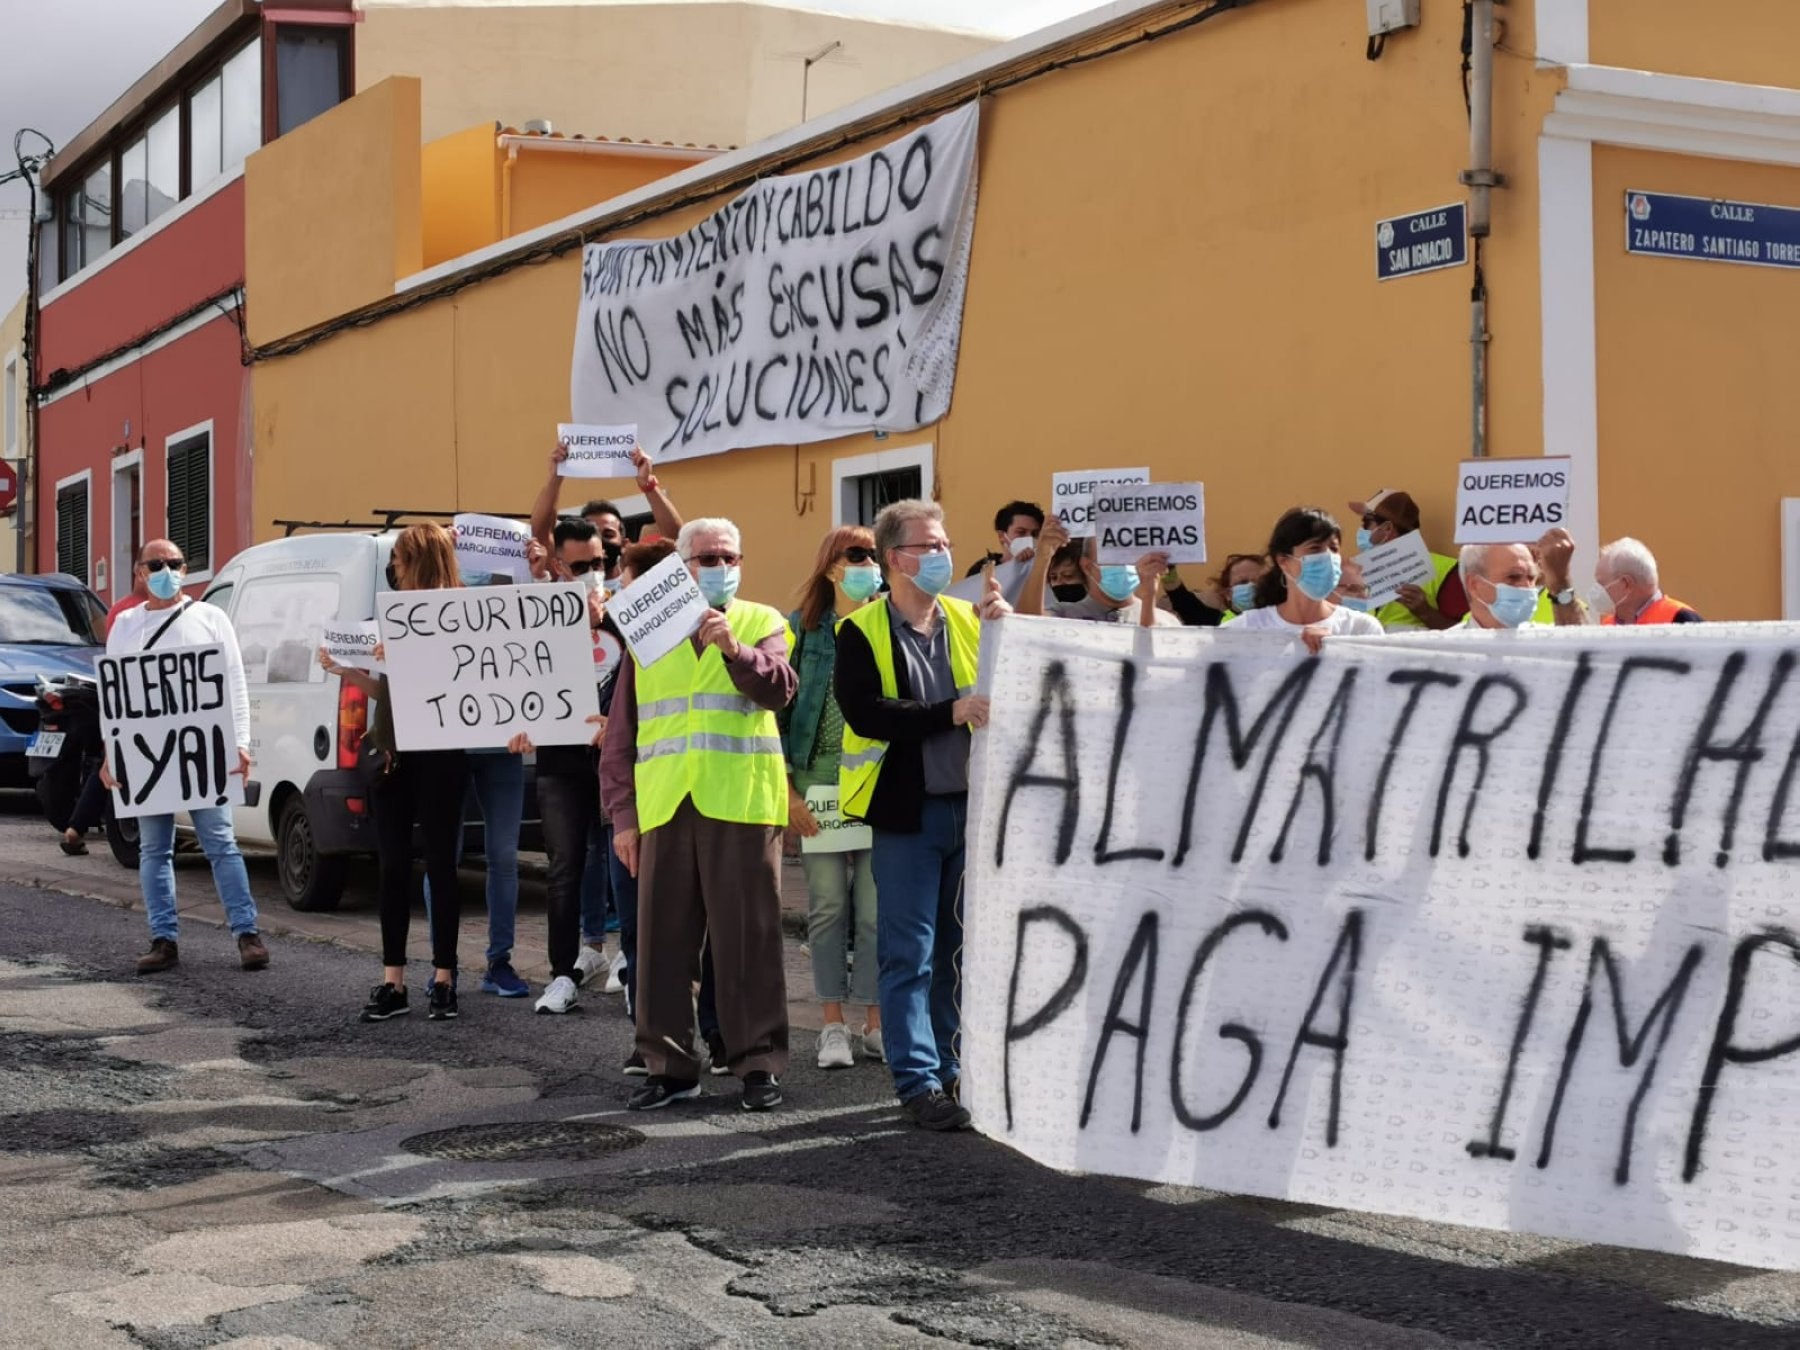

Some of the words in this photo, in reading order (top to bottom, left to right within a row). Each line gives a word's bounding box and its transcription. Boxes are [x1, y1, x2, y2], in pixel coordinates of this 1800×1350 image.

[1409, 211, 1448, 233] CALLE
[1709, 203, 1755, 223] CALLE
[1389, 245, 1411, 272] SAN
[1411, 237, 1453, 268] IGNACIO
[1634, 227, 1696, 252] ZAPATERO
[1702, 234, 1760, 259] SANTIAGO
[593, 305, 651, 394] NO
[675, 272, 745, 360] MÁS
[562, 433, 635, 447] QUEREMOS
[1462, 471, 1566, 491] QUEREMOS
[1097, 494, 1198, 513] QUEREMOS
[1461, 502, 1563, 526] ACERAS
[1101, 525, 1198, 547] ACERAS
[618, 567, 688, 626] QUEREMOS
[628, 586, 699, 645] MARQUESINAS
[451, 640, 553, 682] PARA
[98, 648, 224, 720] ACERAS
[425, 688, 574, 729] TODOS
[1005, 904, 1363, 1149] PAGA
